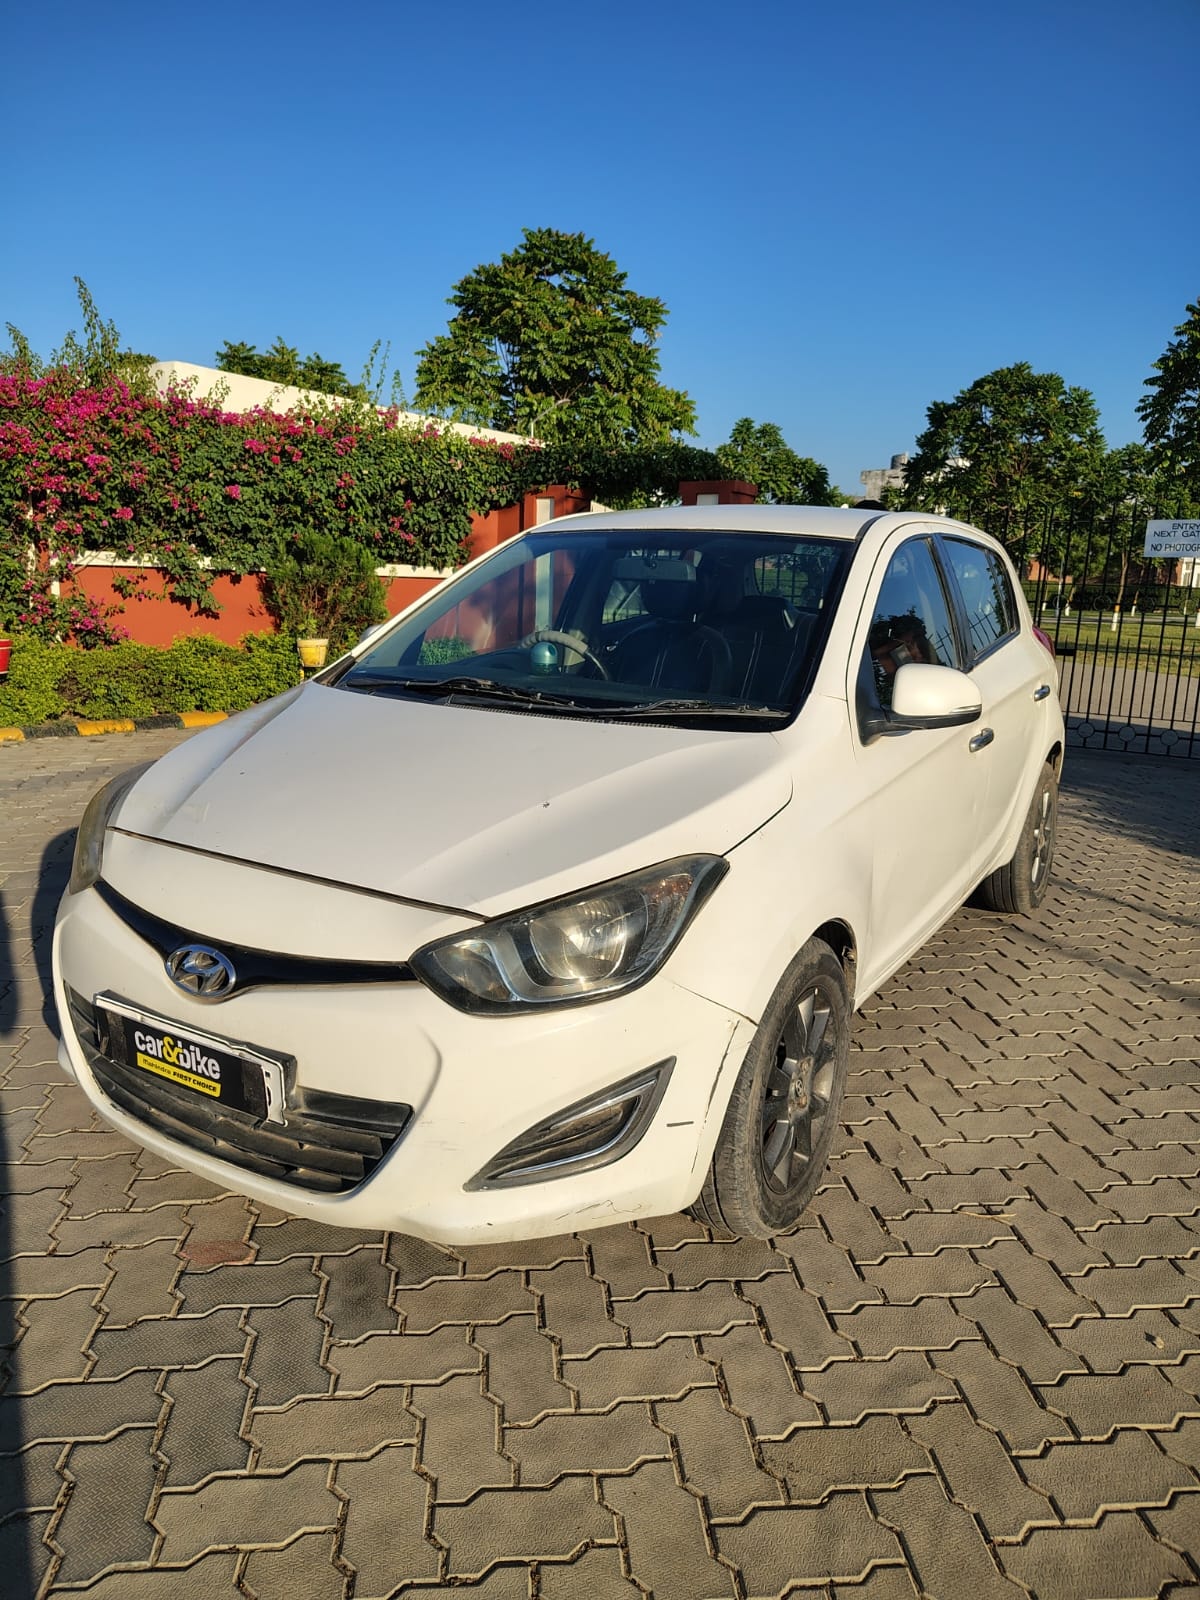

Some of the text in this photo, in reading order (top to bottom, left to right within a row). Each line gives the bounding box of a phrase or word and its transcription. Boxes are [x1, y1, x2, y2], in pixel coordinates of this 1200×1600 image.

[1151, 543, 1162, 551] NO
[134, 1030, 221, 1080] car&bike
[172, 1071, 192, 1084] FIRST
[192, 1079, 217, 1092] CHOICE
